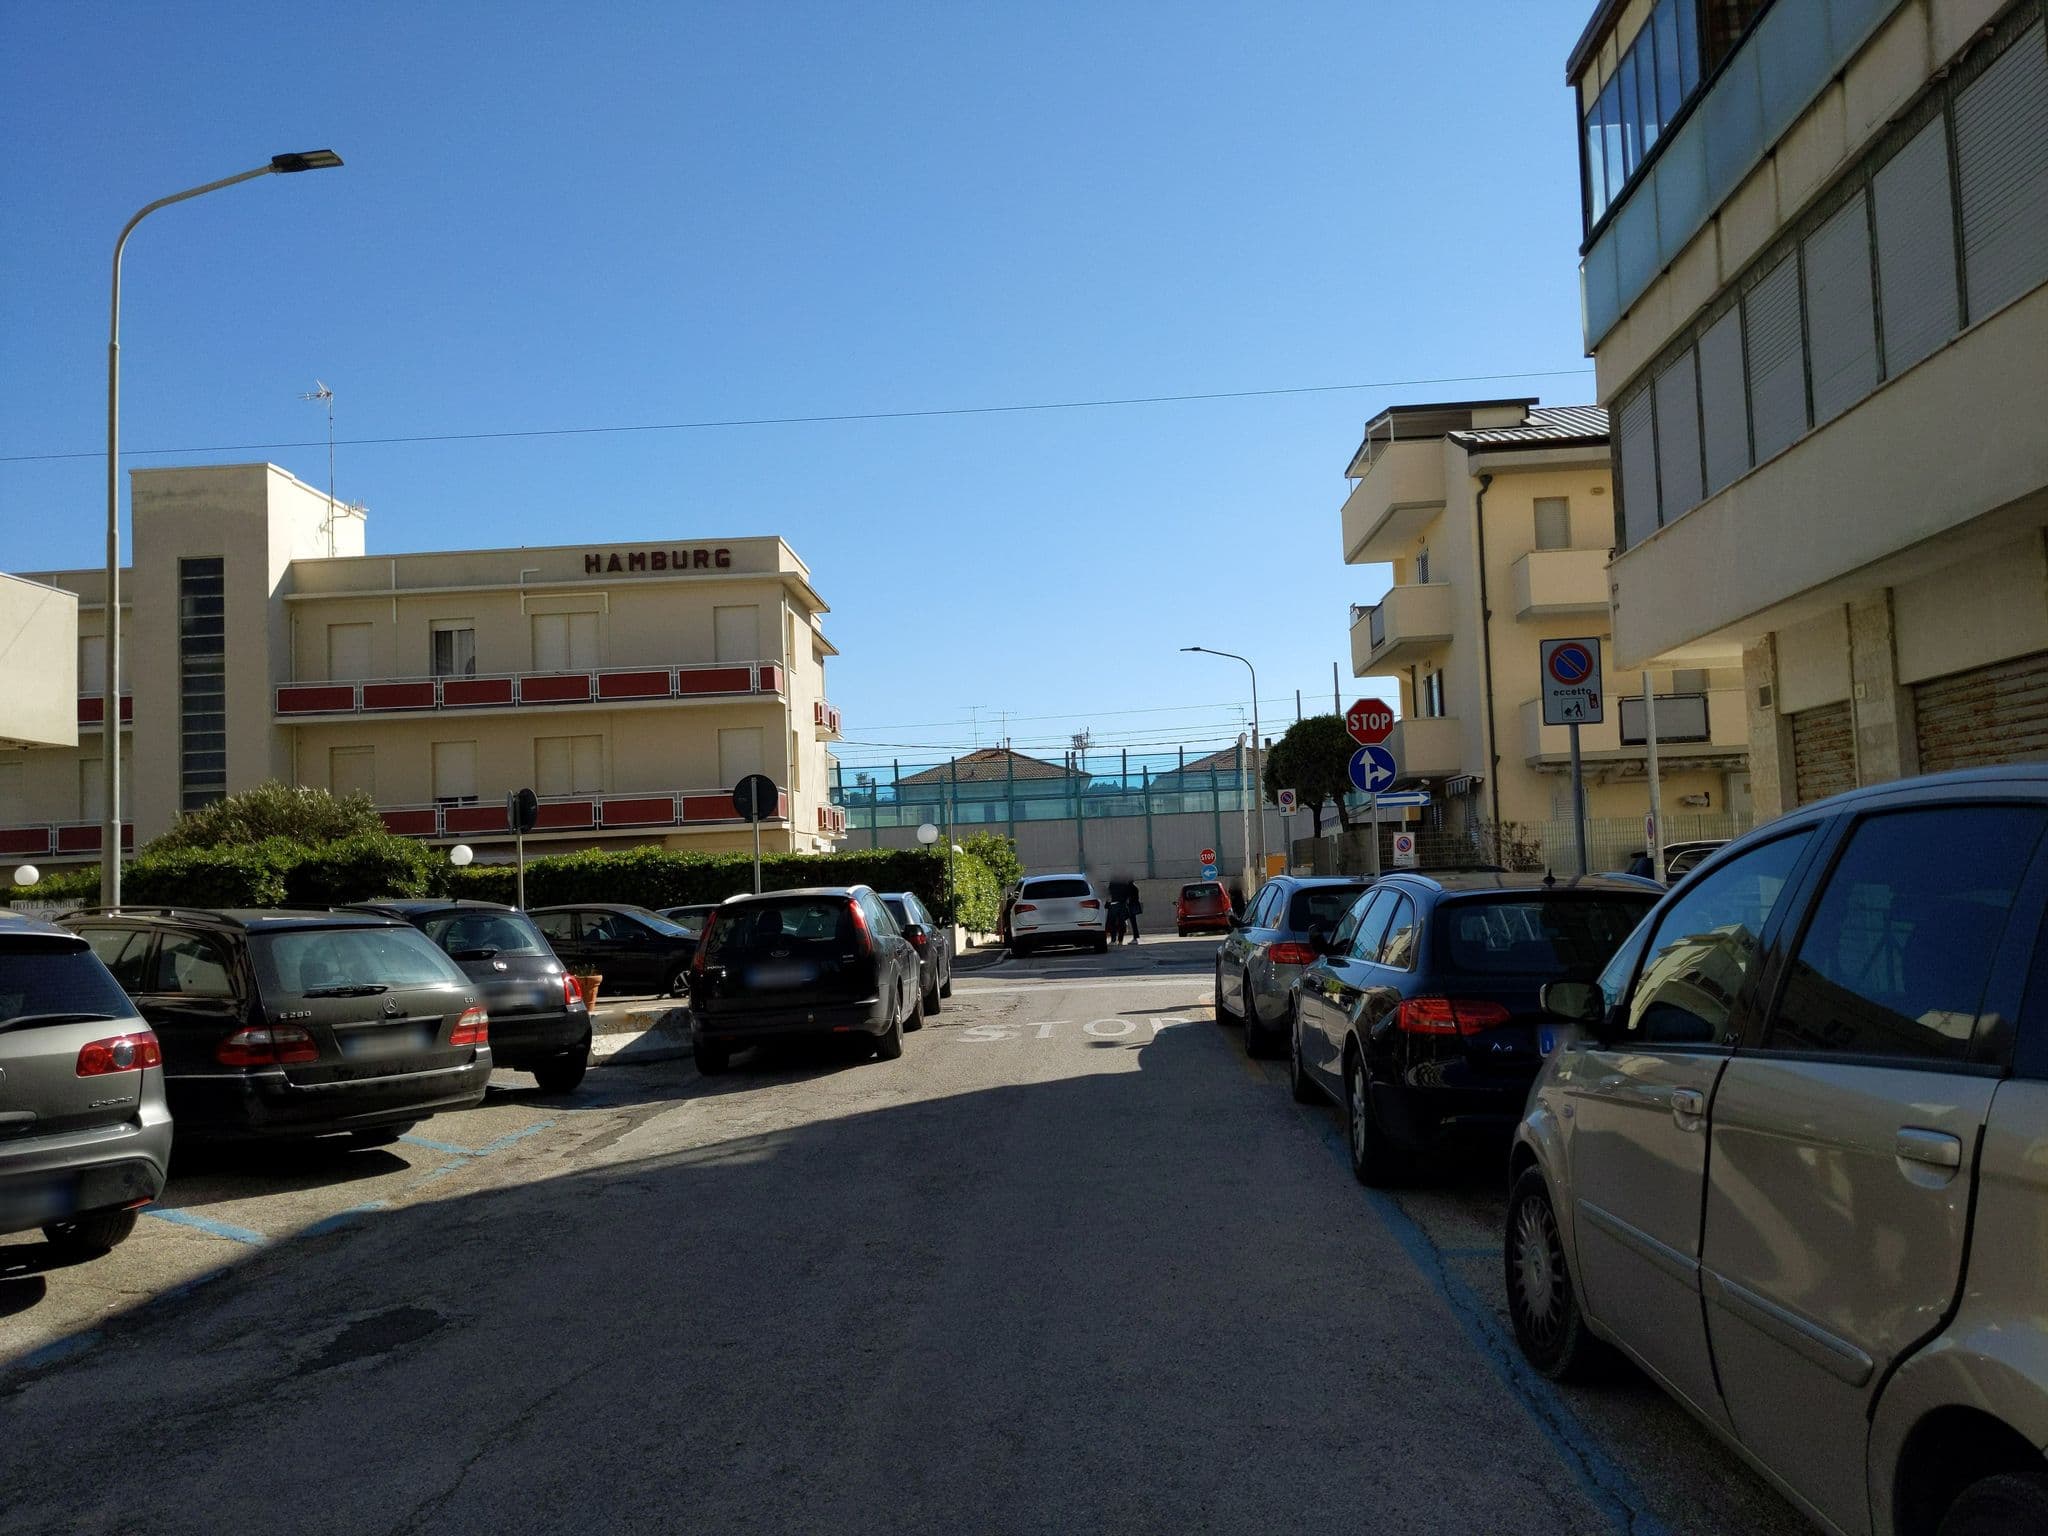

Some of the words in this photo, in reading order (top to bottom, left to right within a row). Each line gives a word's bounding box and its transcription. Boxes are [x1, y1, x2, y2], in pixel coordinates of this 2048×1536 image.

[584, 548, 731, 574] HAMBURG
[1553, 687, 1592, 697] eccetto
[1350, 712, 1391, 731] STOP
[1200, 853, 1215, 861] STOP
